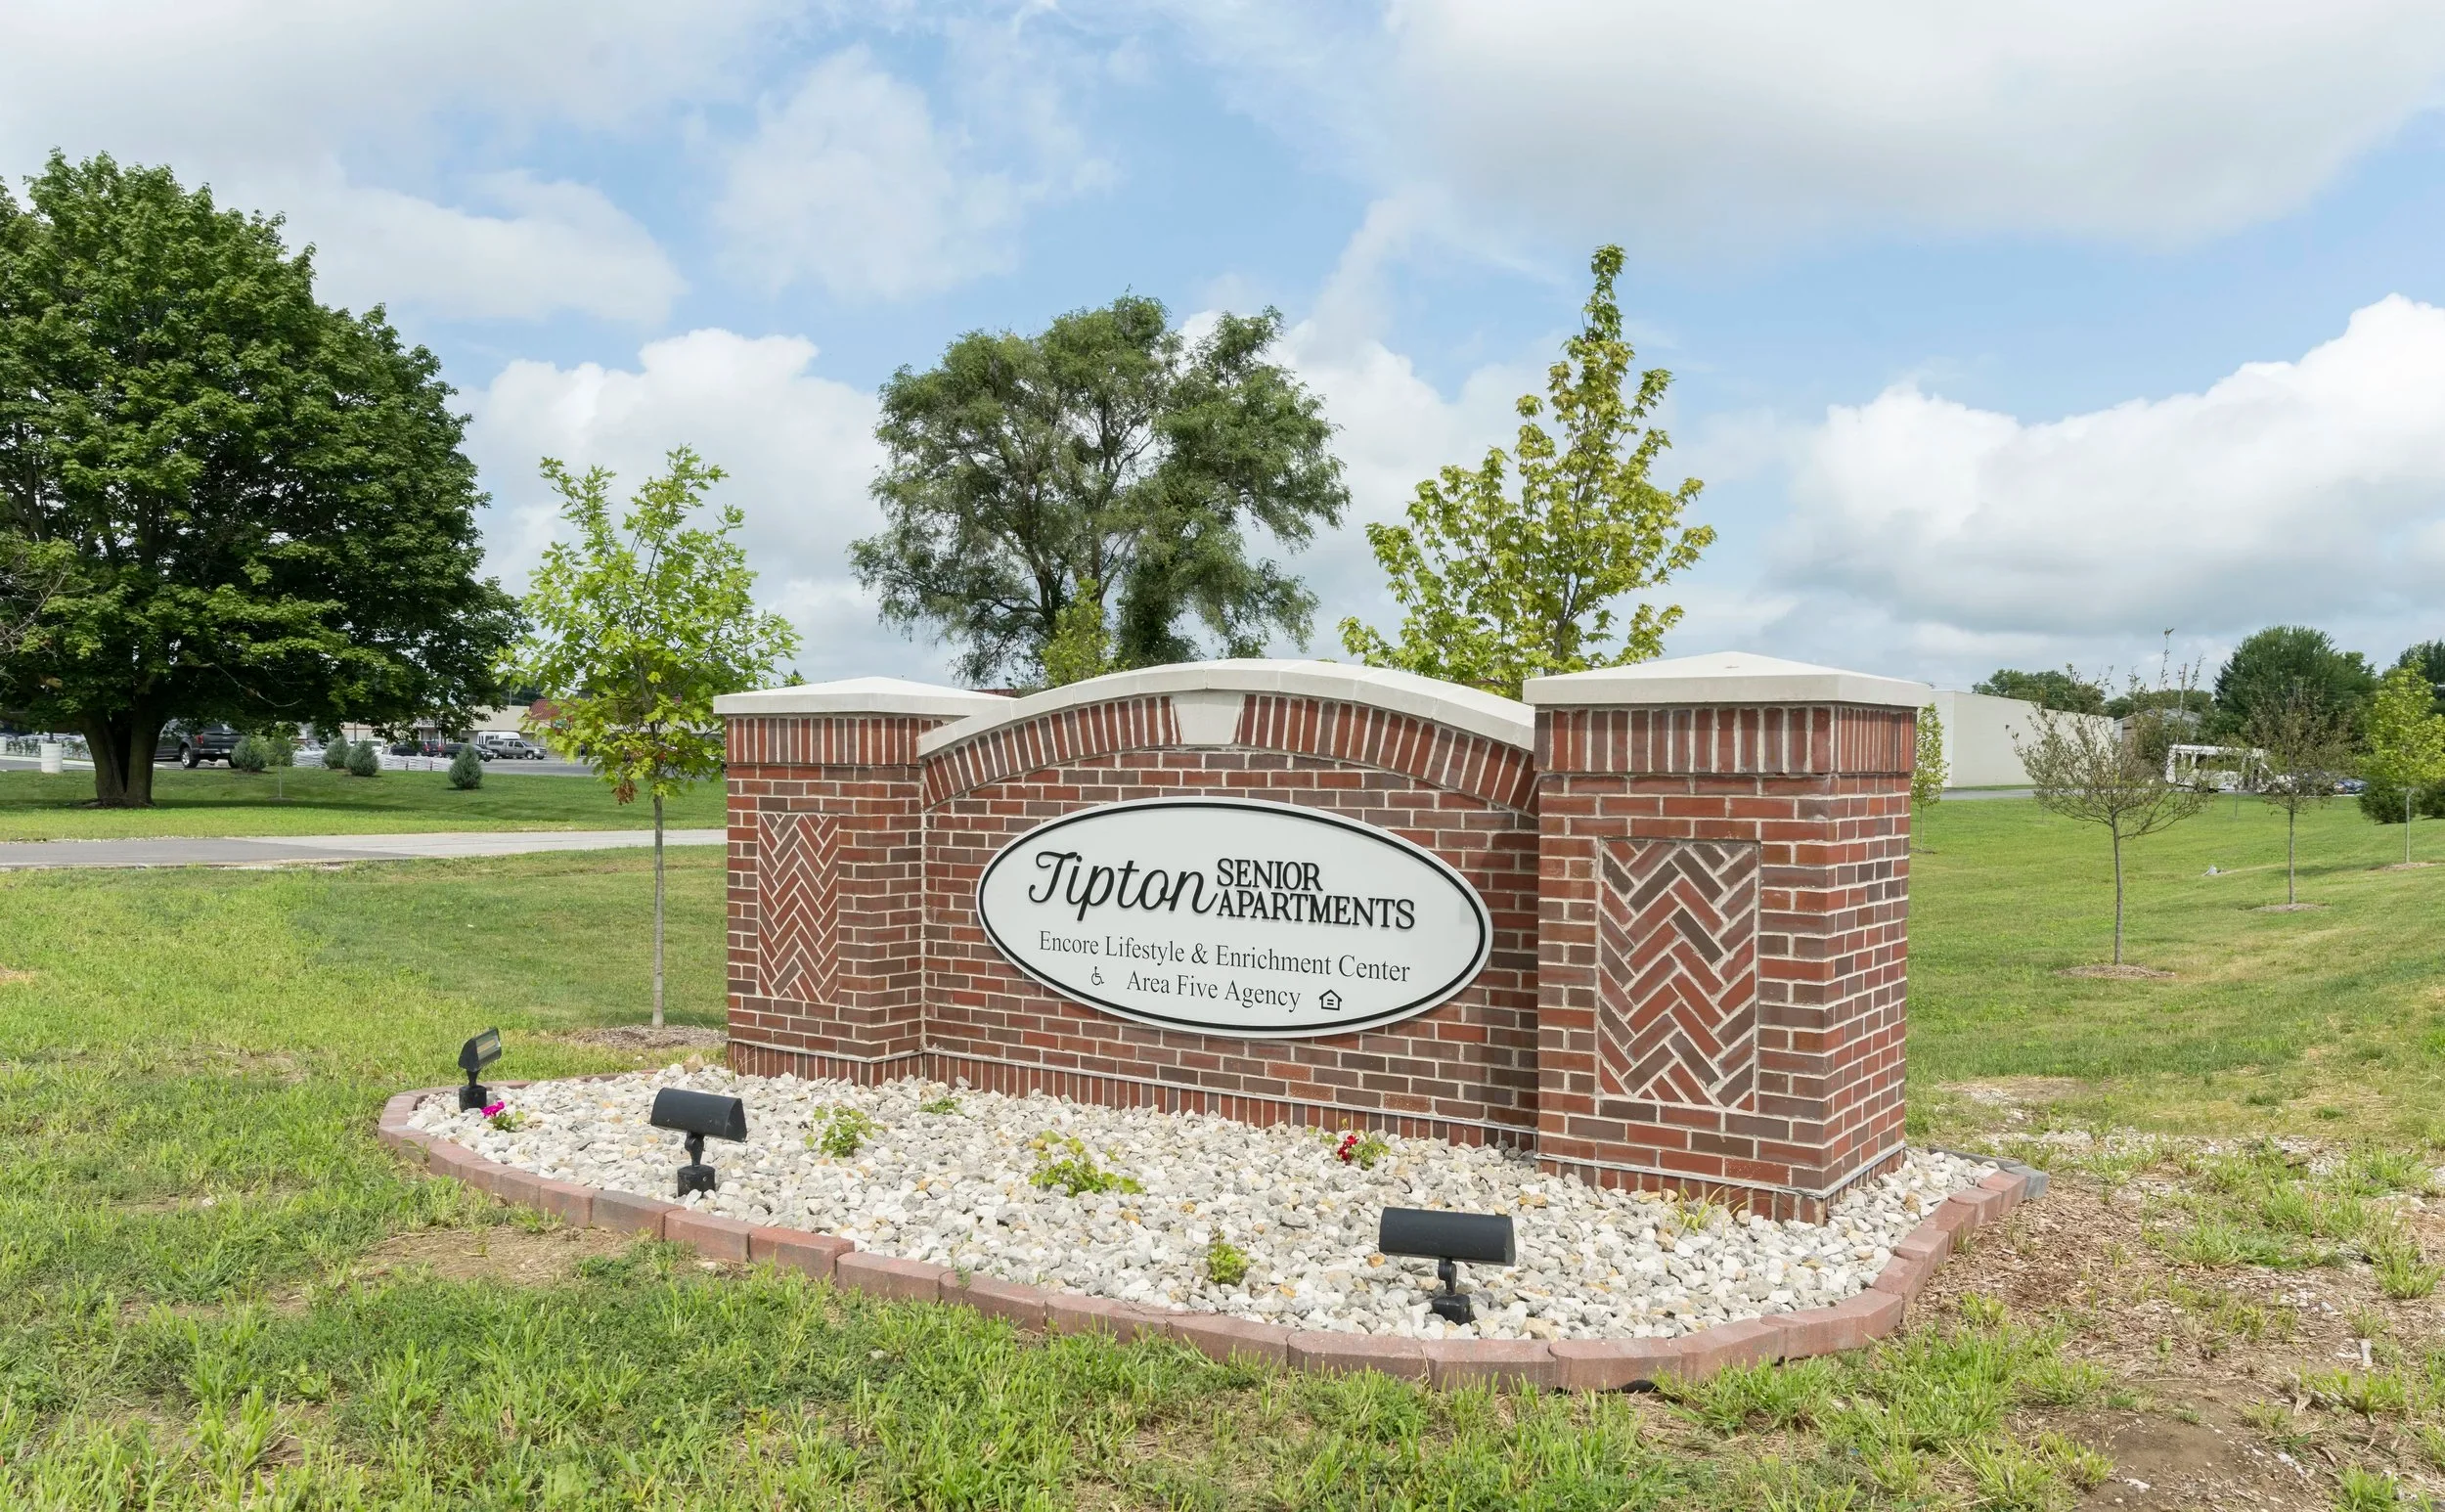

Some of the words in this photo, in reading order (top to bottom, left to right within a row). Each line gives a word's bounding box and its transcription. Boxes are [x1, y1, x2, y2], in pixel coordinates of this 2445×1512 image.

[1028, 850, 1218, 922] Tipton
[1216, 858, 1324, 892] SENIOR
[1216, 888, 1416, 930] APARTMENTS
[1039, 930, 1099, 956] Encore
[1105, 935, 1185, 966] Lifestyle
[1190, 942, 1209, 965] &
[1216, 944, 1332, 976] Enrichment
[1338, 955, 1410, 982] Center
[1126, 970, 1171, 995] Area
[1177, 974, 1219, 1000] Five
[1223, 979, 1302, 1013] Agency
